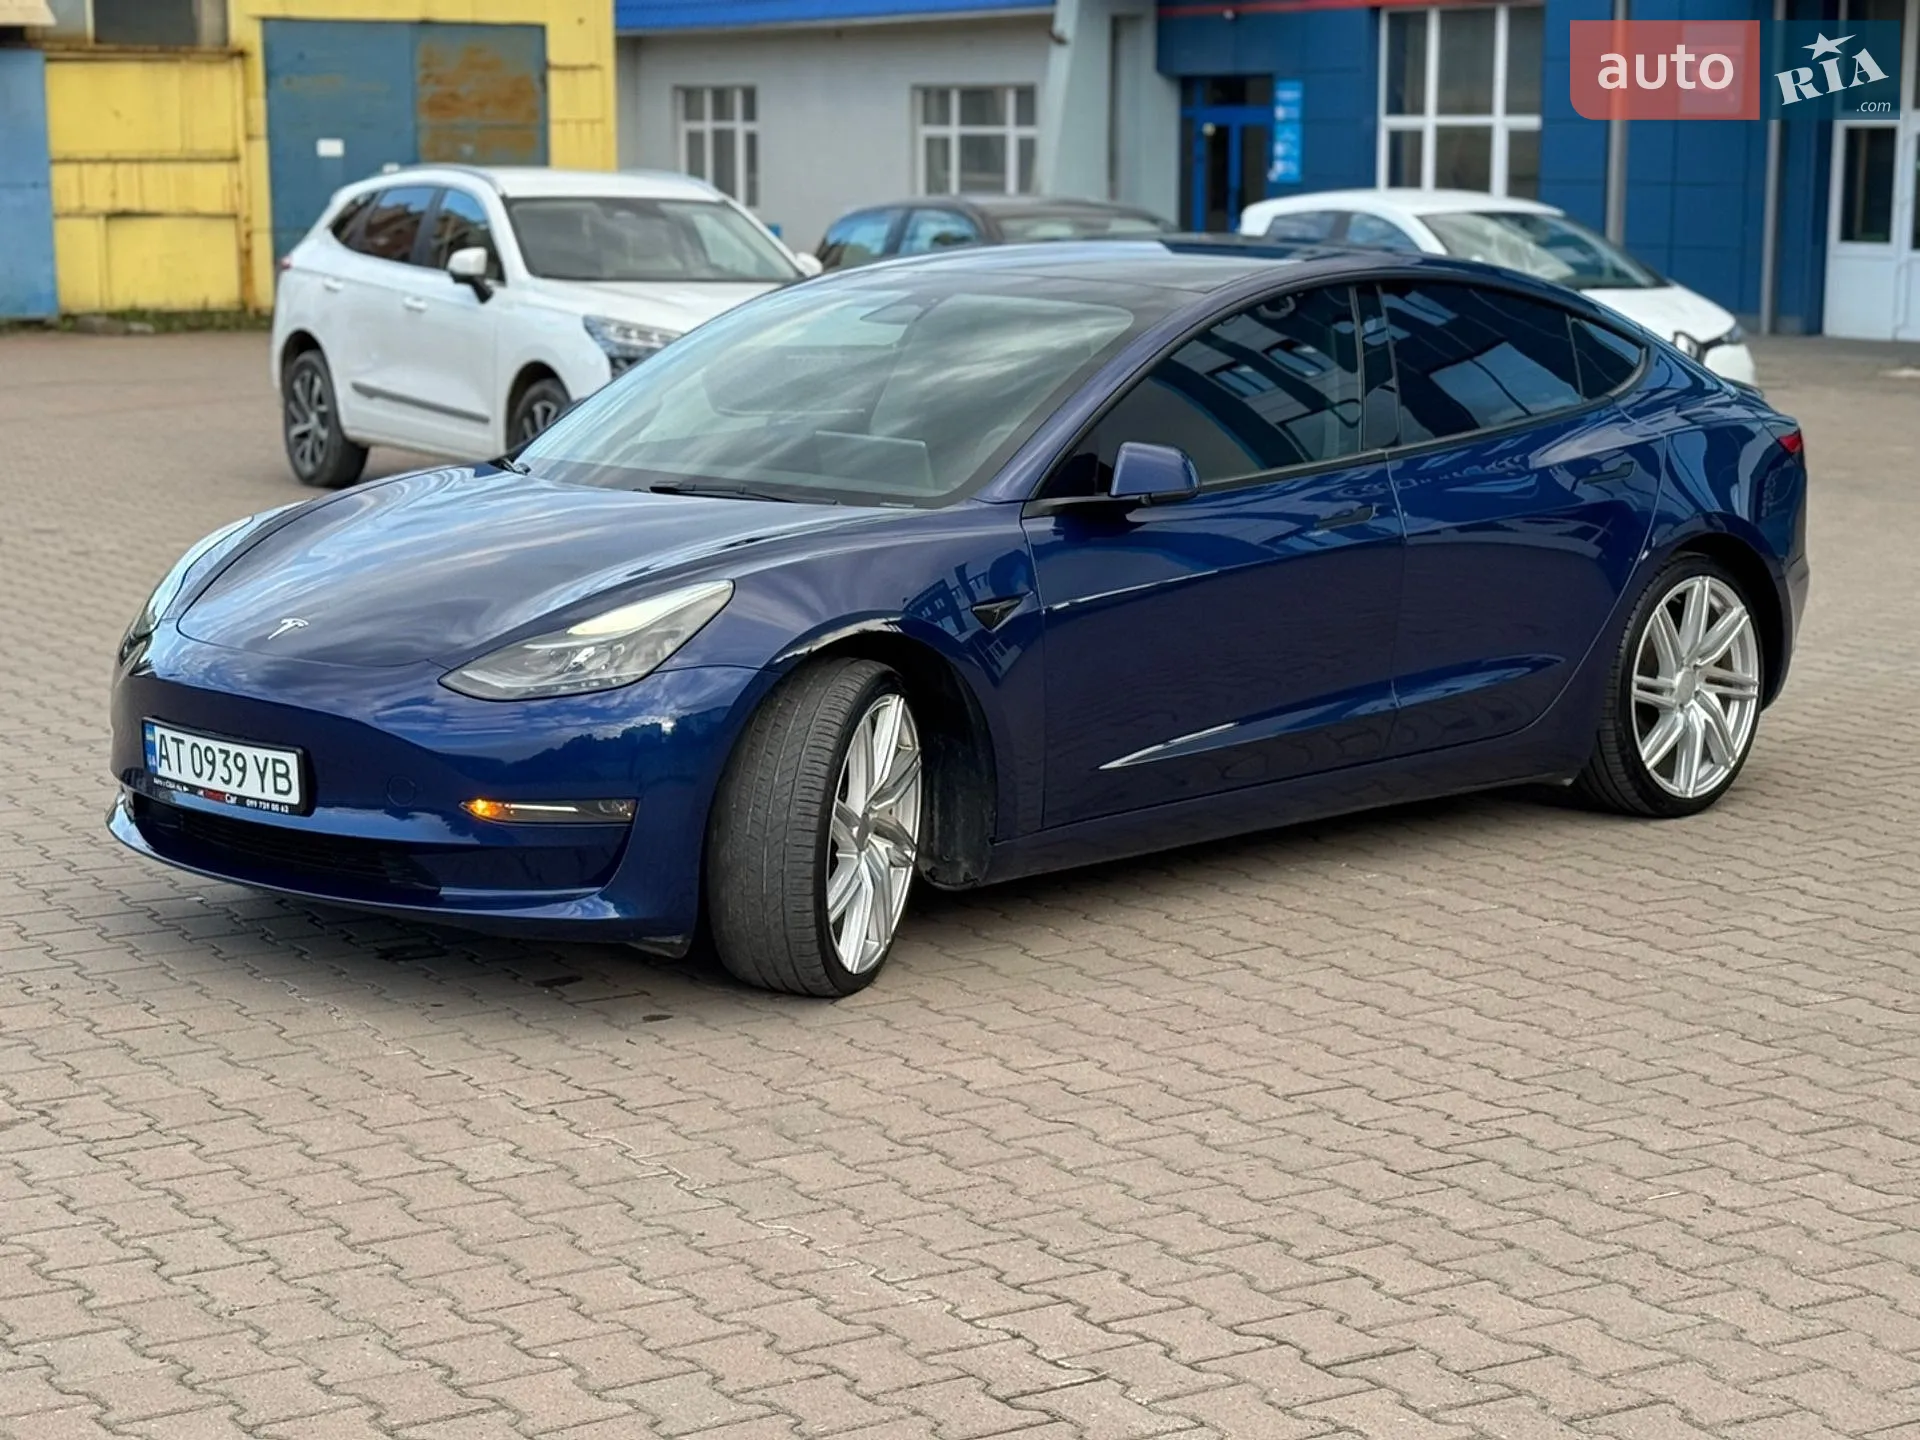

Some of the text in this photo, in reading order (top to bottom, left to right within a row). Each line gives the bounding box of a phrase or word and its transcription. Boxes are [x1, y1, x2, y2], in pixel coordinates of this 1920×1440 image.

[159, 733, 292, 796] AT 0939 YB
